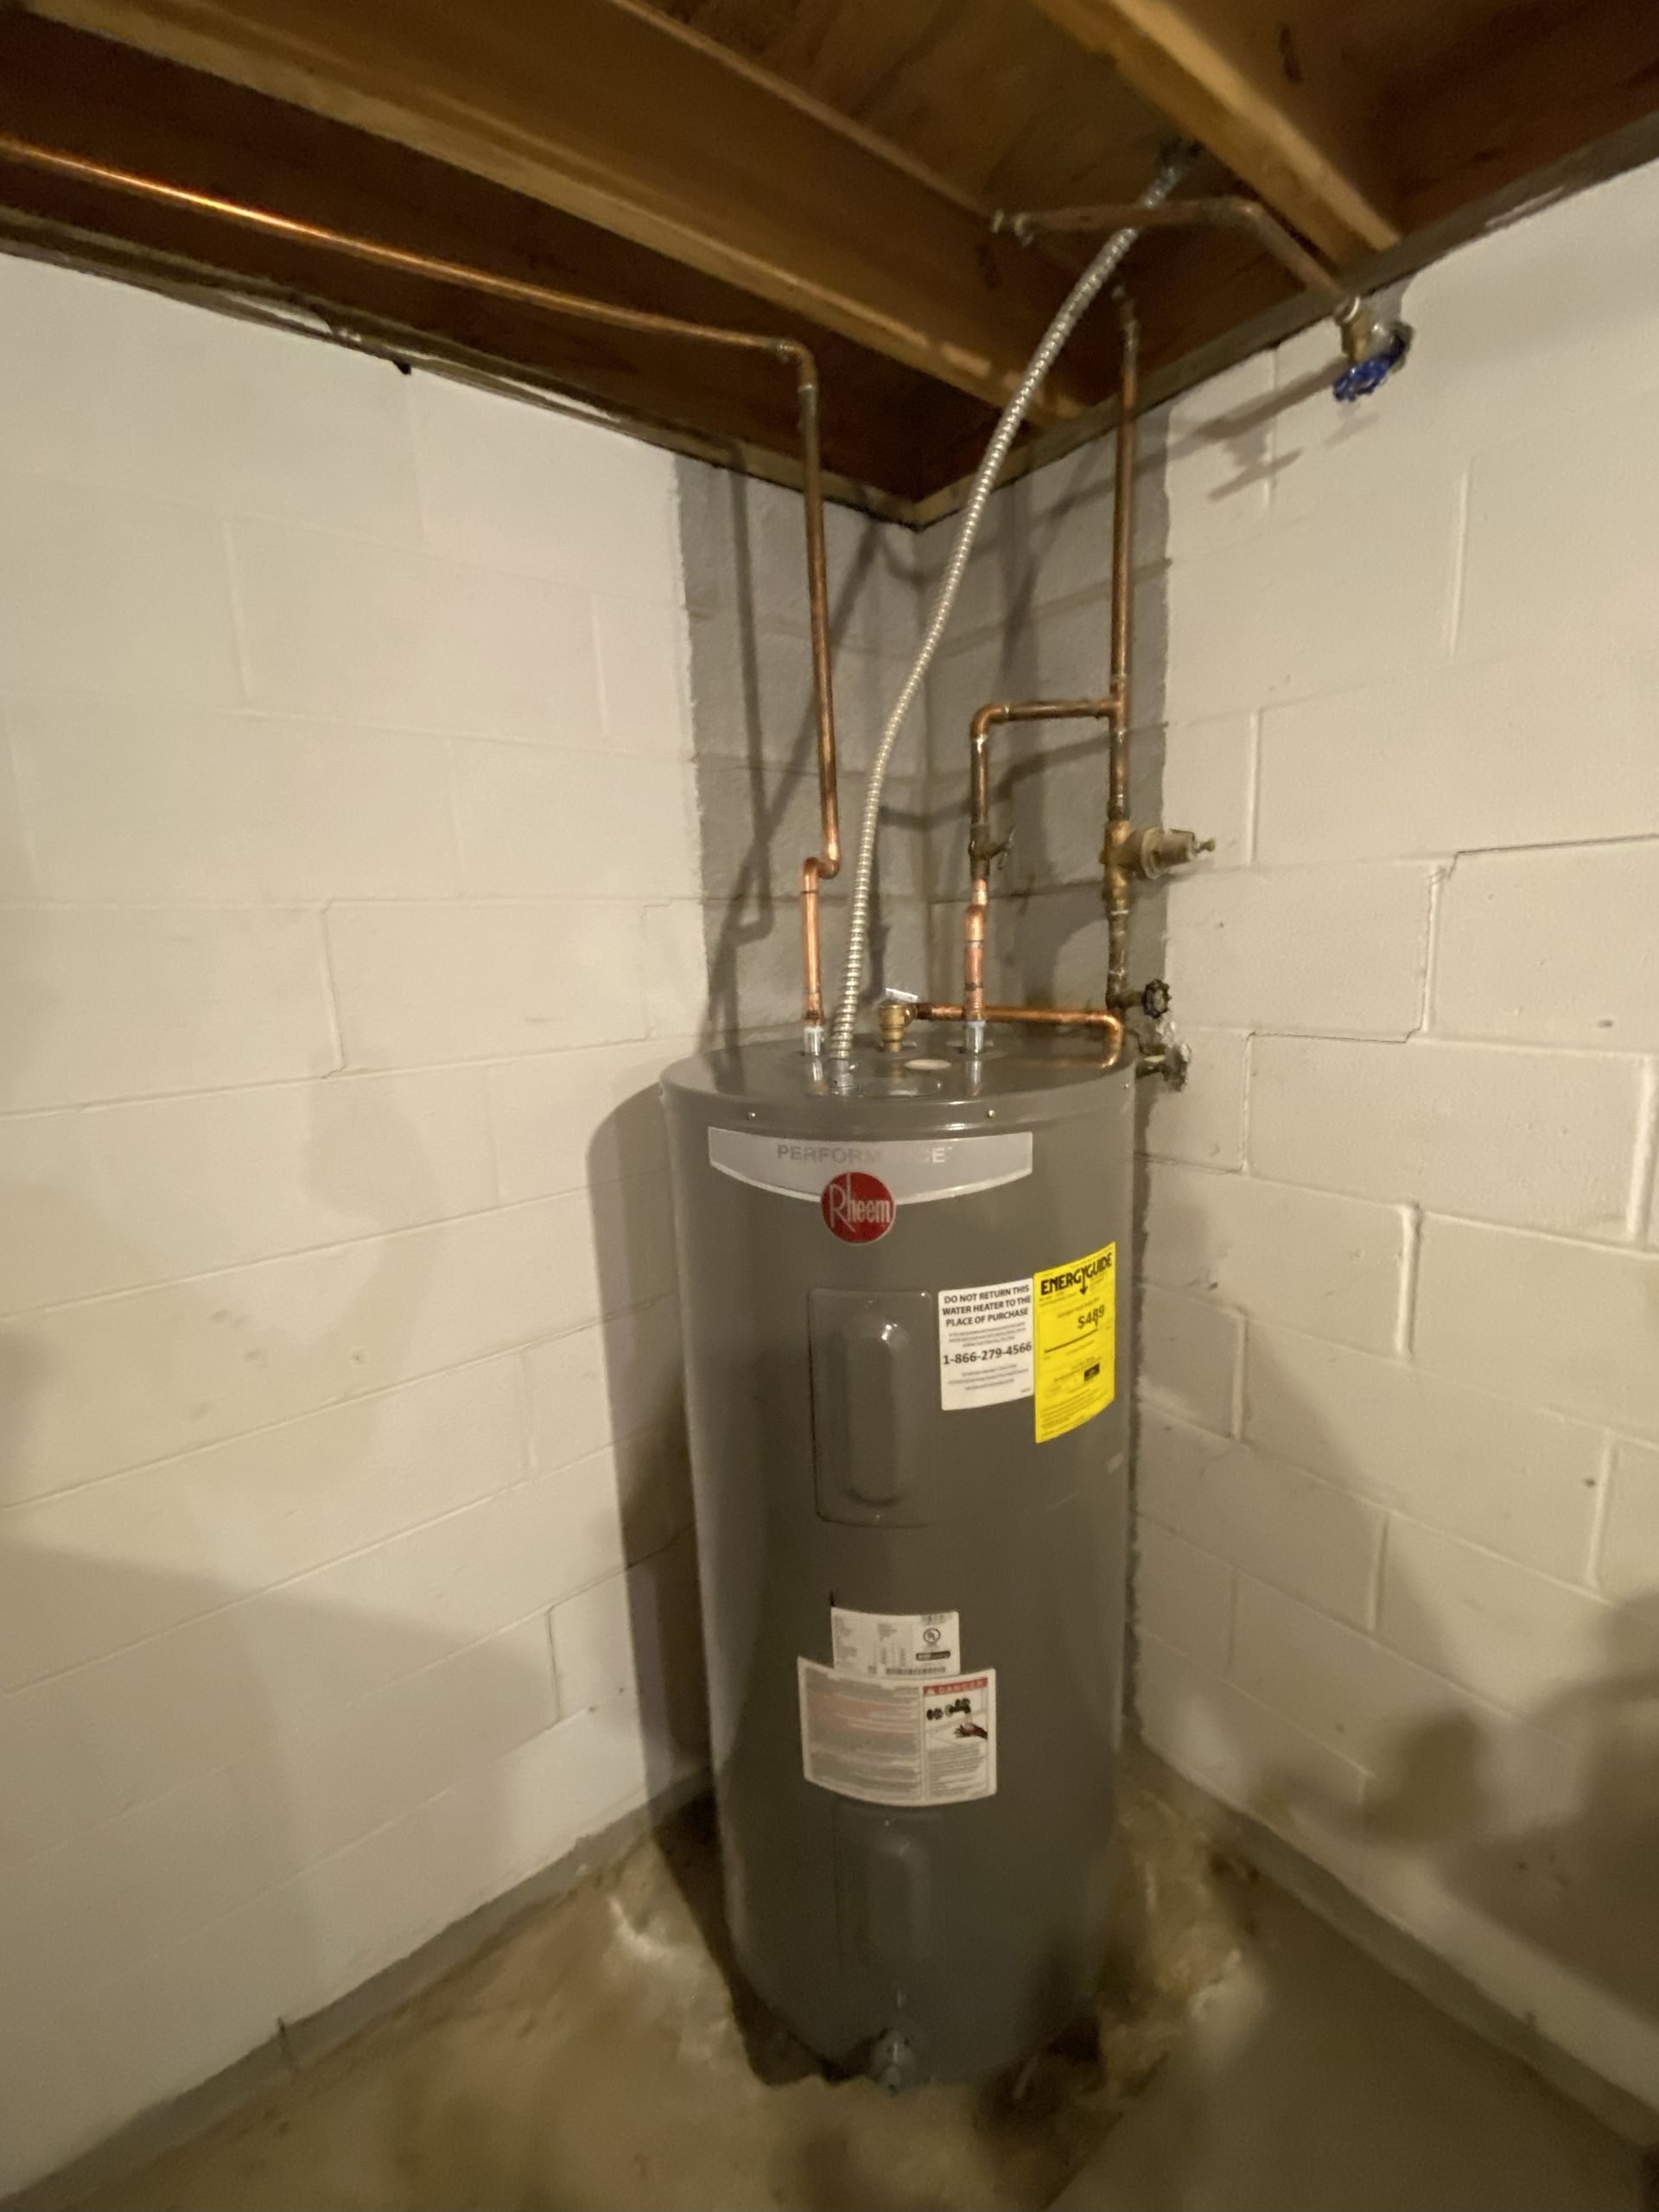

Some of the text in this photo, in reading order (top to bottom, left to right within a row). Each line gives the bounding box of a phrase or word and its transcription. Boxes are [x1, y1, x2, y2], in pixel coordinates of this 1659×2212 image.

[778, 1144, 945, 1164] PERFORMCE
[829, 1173, 890, 1232] Rheem
[944, 1284, 1030, 1304] DO NOT RETURN THIS
[942, 1305, 972, 1316] WATER
[973, 1301, 1004, 1313] HEATER
[1005, 1299, 1016, 1307] TO
[1017, 1294, 1032, 1305] THE
[945, 1306, 1029, 1327] PLACE OF PURCHASE
[943, 1341, 1033, 1365] 1-866-279-4566
